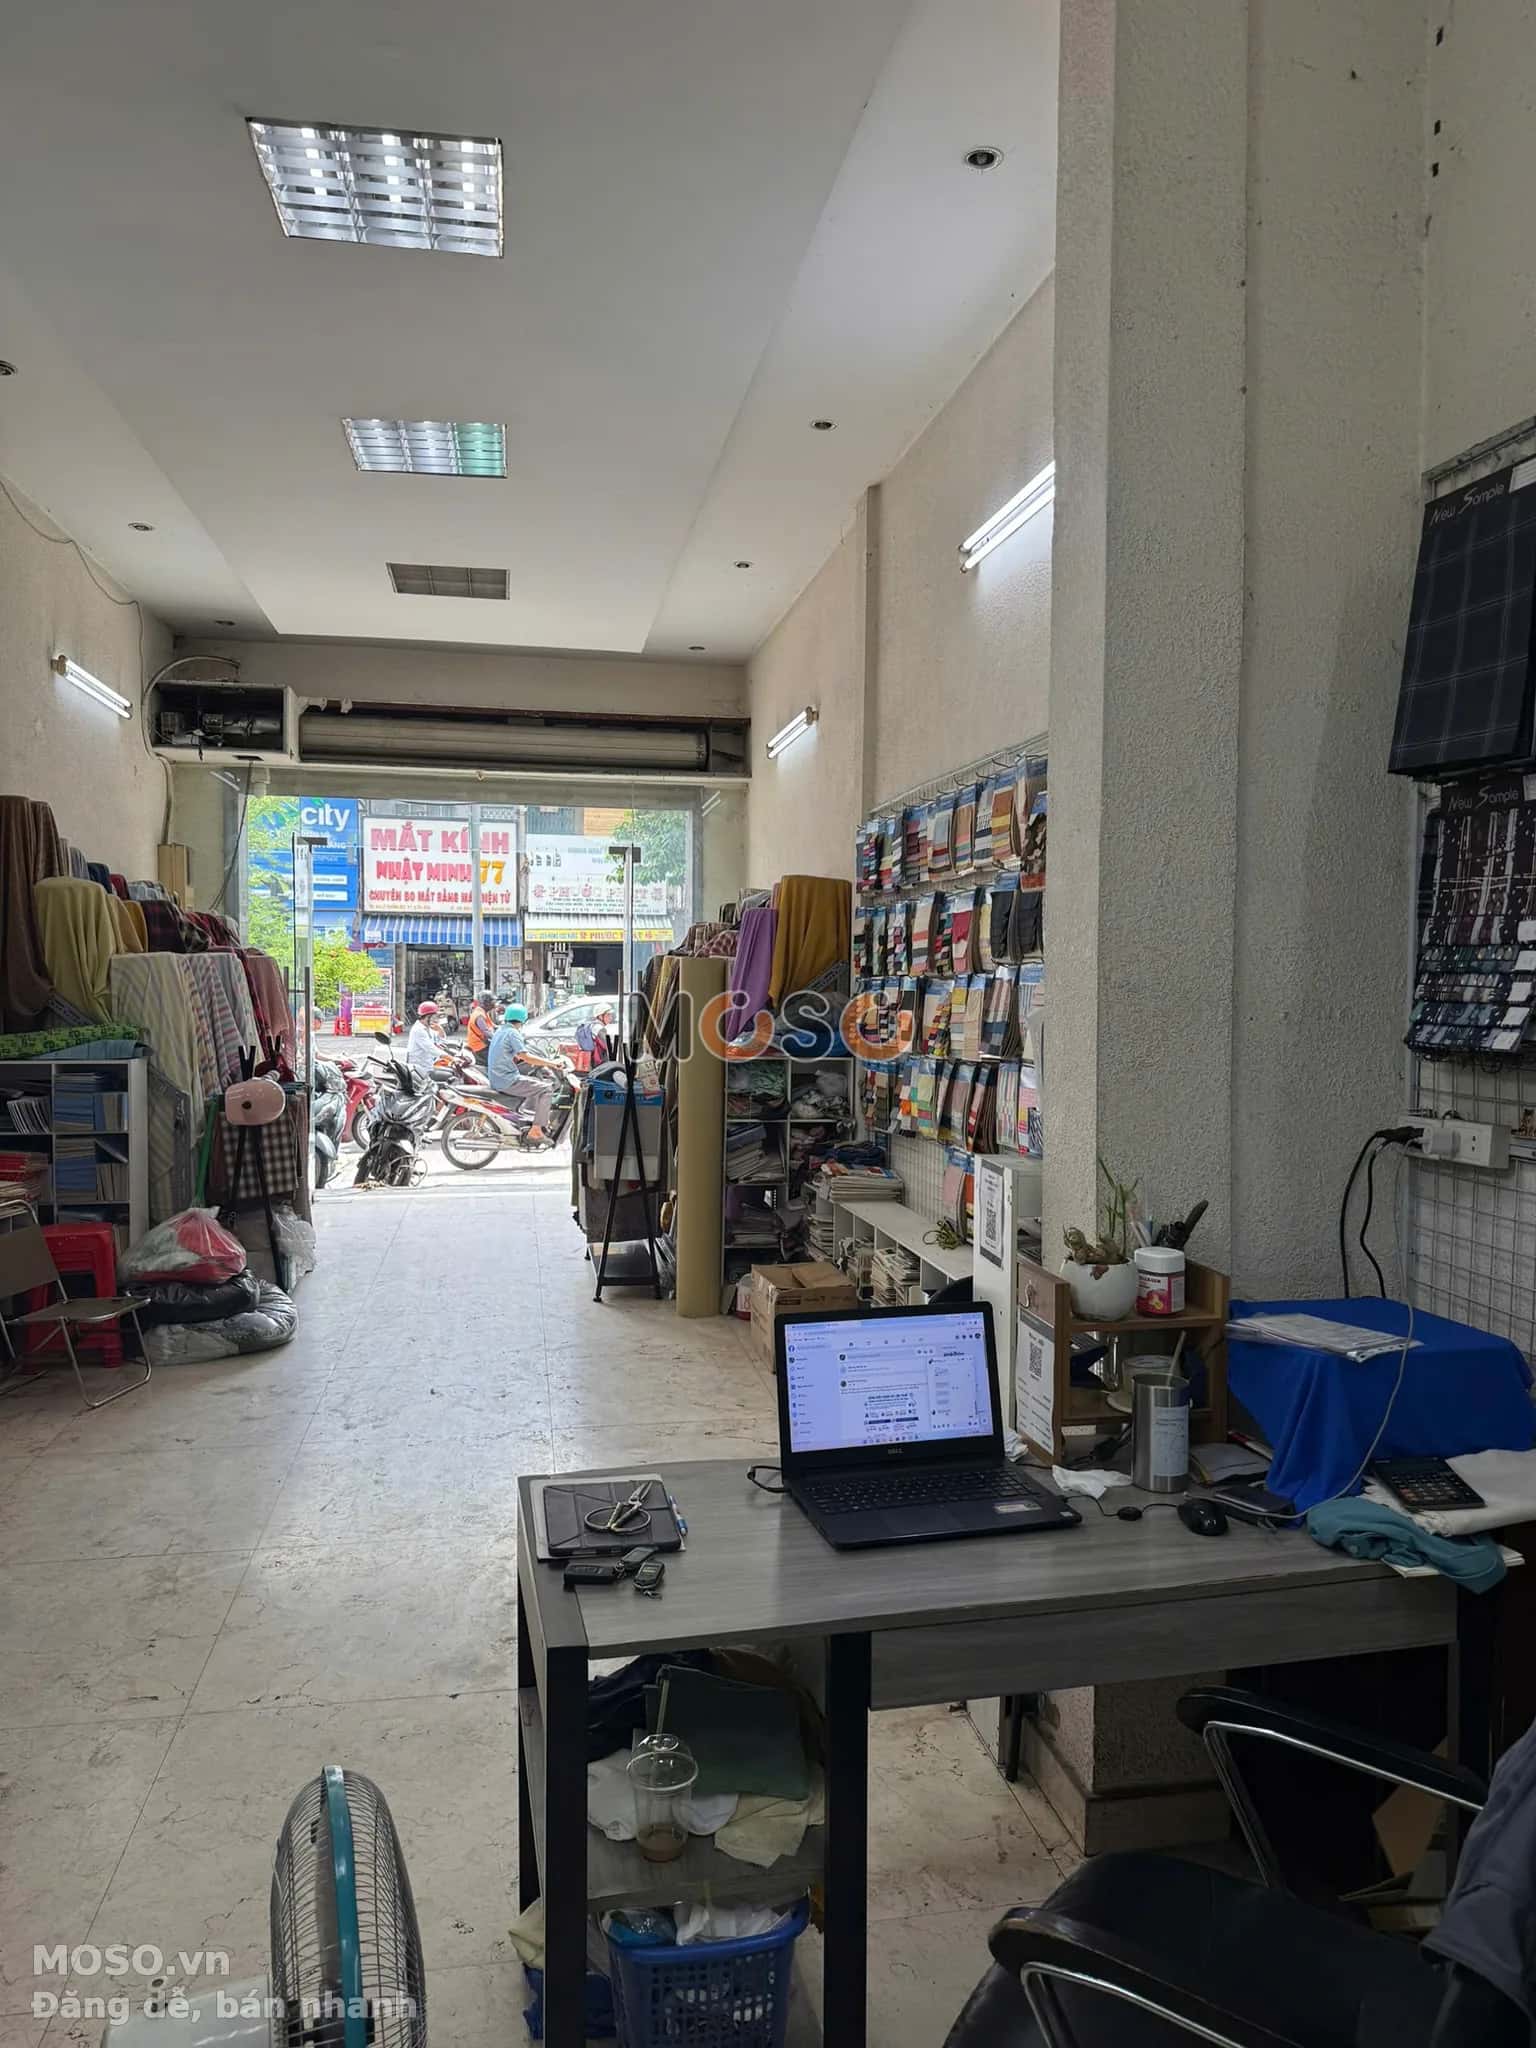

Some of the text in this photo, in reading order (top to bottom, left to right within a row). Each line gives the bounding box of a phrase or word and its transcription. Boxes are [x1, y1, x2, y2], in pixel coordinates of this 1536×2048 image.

[1458, 486, 1505, 514] Sample
[1475, 785, 1519, 810] Sample
[301, 803, 350, 832] city
[370, 821, 510, 855] MẮT KÍNH
[376, 857, 507, 886] NHẬT MINH 77
